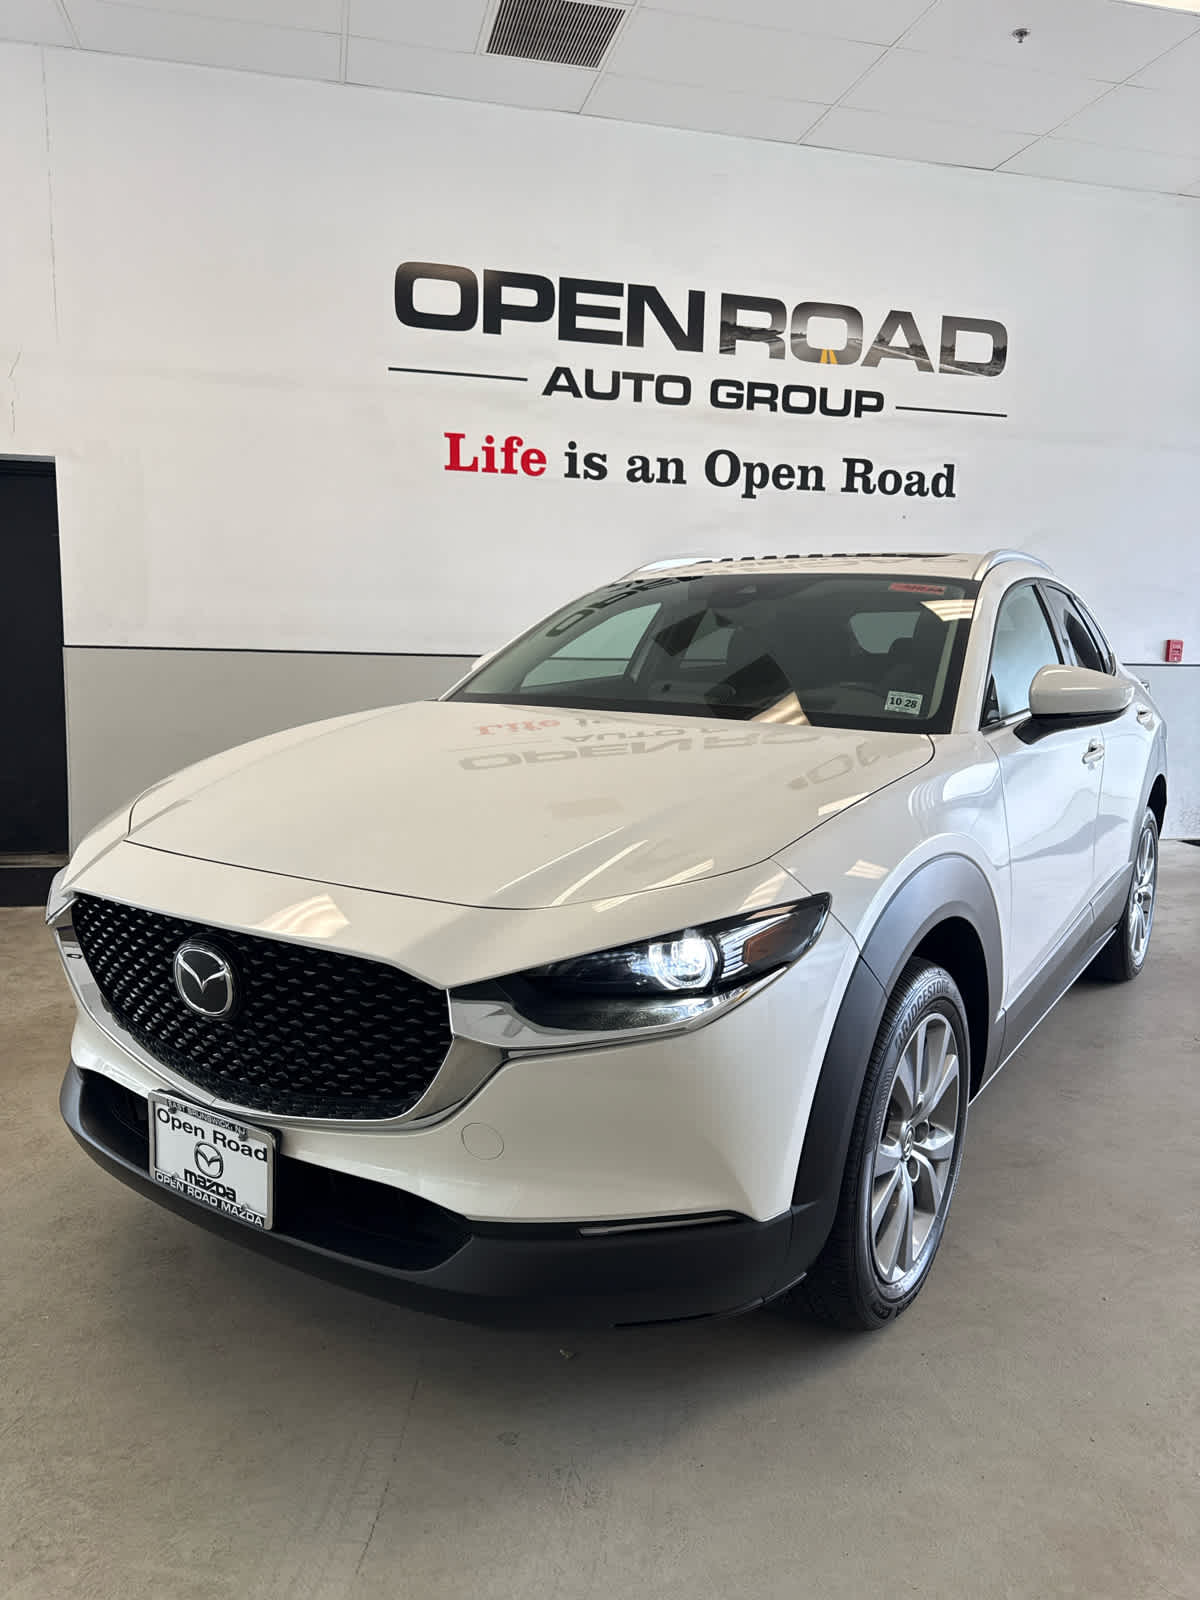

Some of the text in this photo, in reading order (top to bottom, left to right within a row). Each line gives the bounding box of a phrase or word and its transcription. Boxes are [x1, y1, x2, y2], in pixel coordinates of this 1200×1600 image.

[394, 262, 1008, 377] OPEN ROAD
[542, 366, 884, 419] AUTO GROUP
[443, 432, 956, 500] Life is an Open Road
[889, 696, 918, 709] 10 28
[156, 1107, 268, 1163] Open Road
[156, 1171, 264, 1227] OPEN ROAD MAZDA
